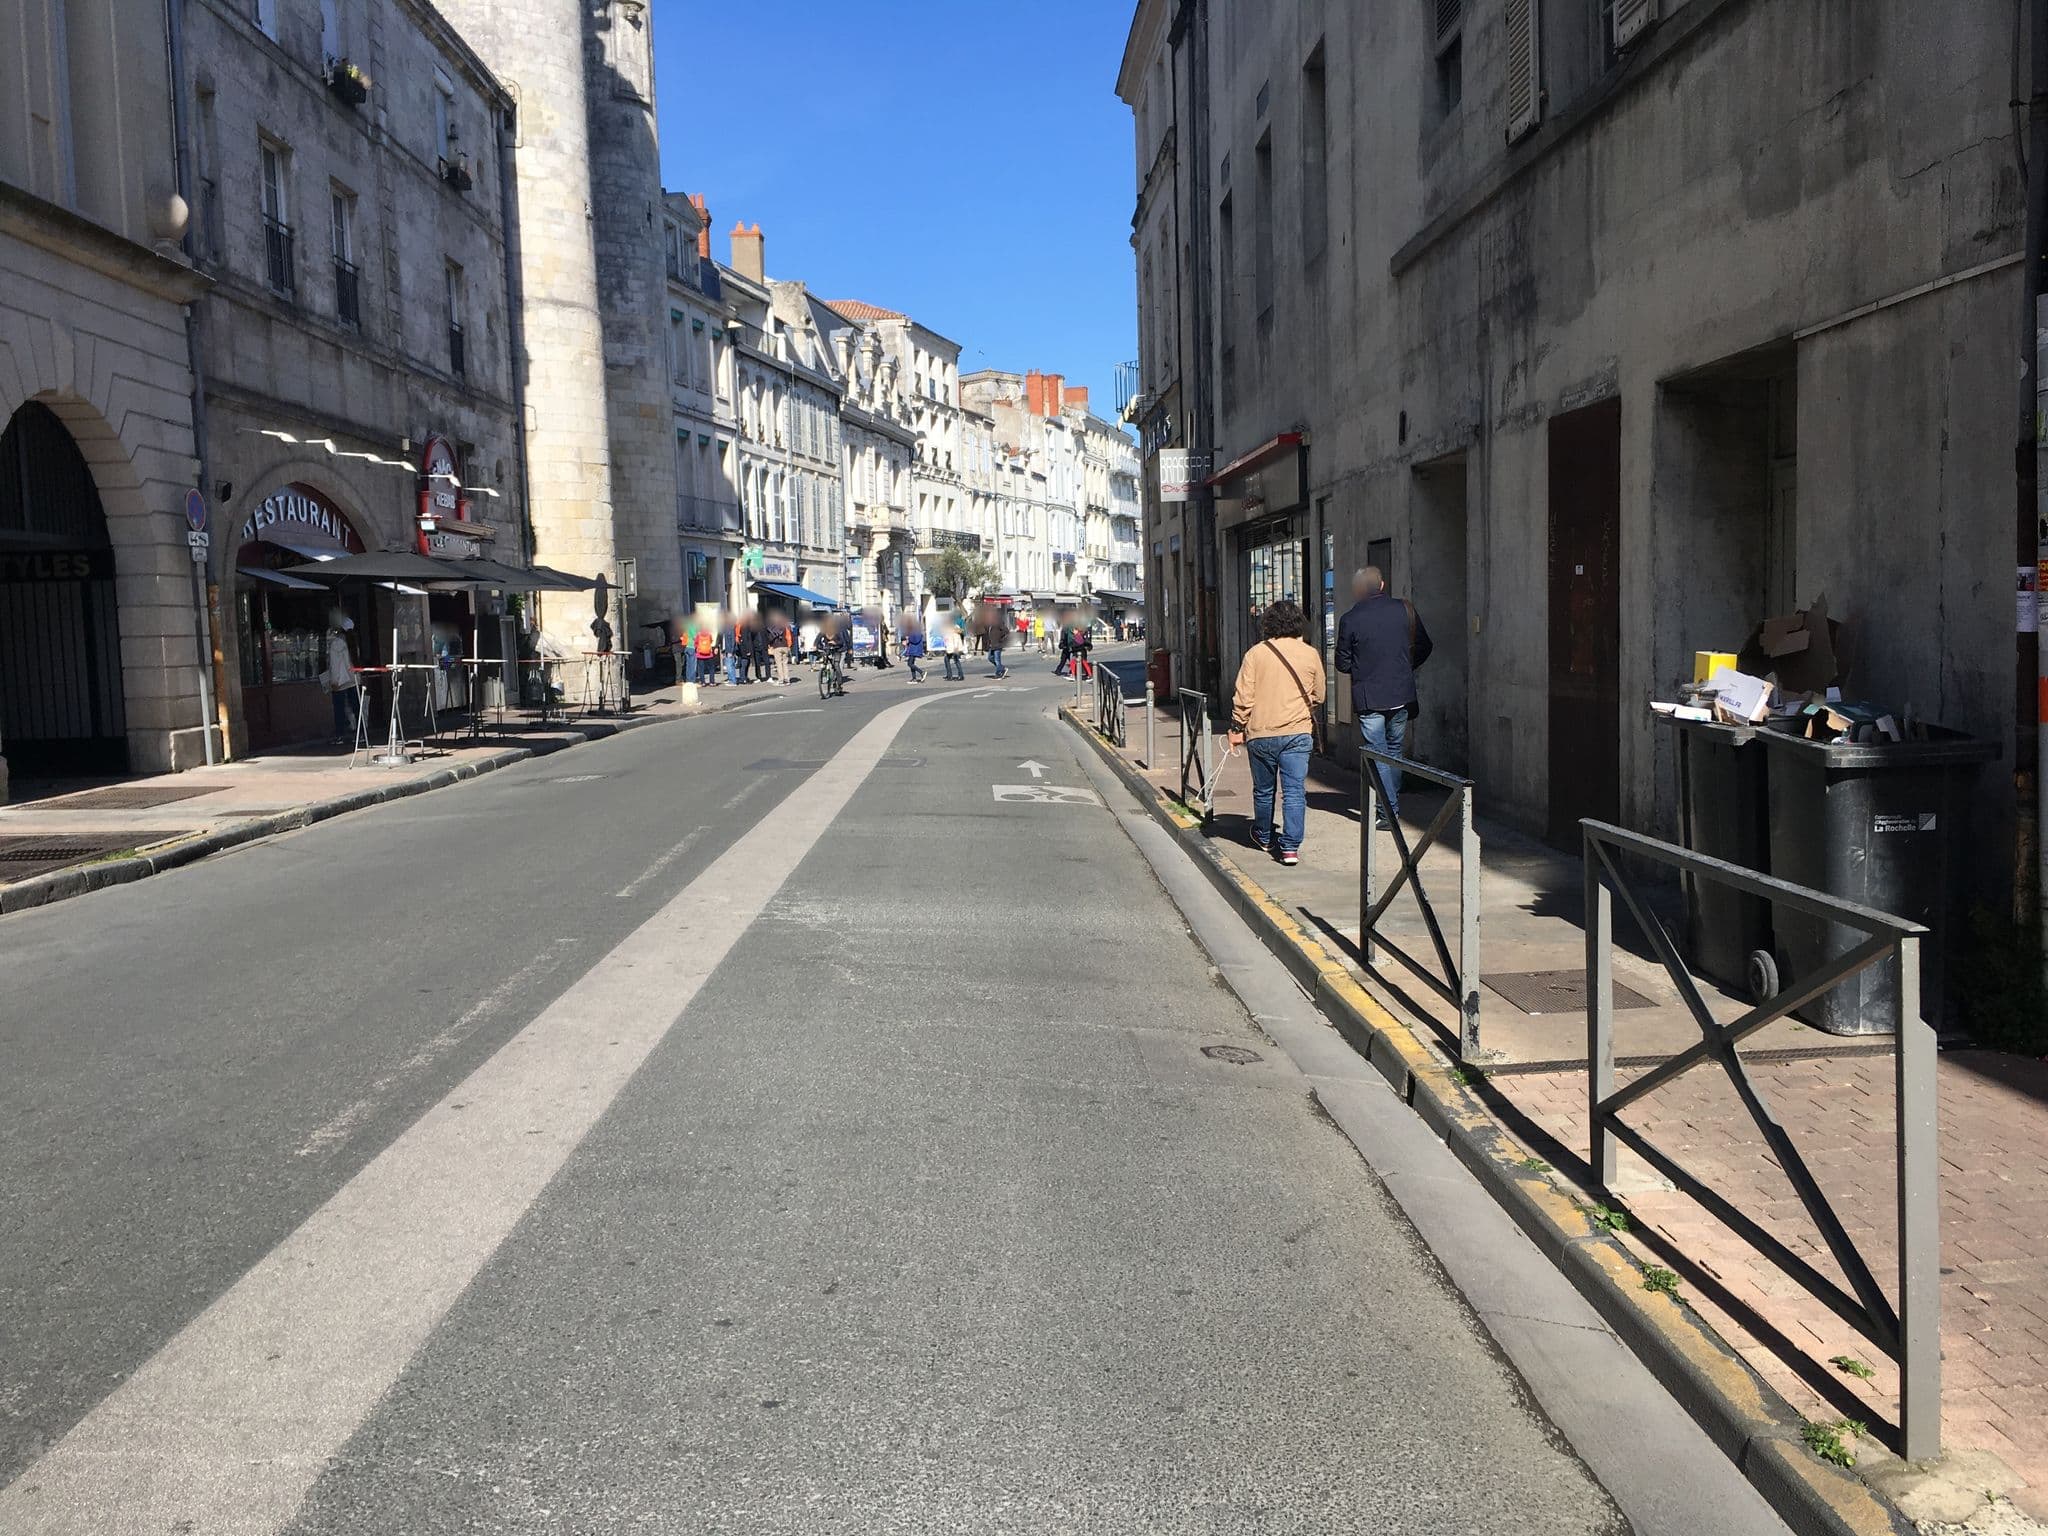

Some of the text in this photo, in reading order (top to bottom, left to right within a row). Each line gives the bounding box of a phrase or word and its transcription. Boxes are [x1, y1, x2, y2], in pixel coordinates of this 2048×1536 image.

[436, 492, 456, 509] KEBAB
[243, 495, 350, 548] RESTAURANT
[1885, 824, 1917, 832] Rochelle
